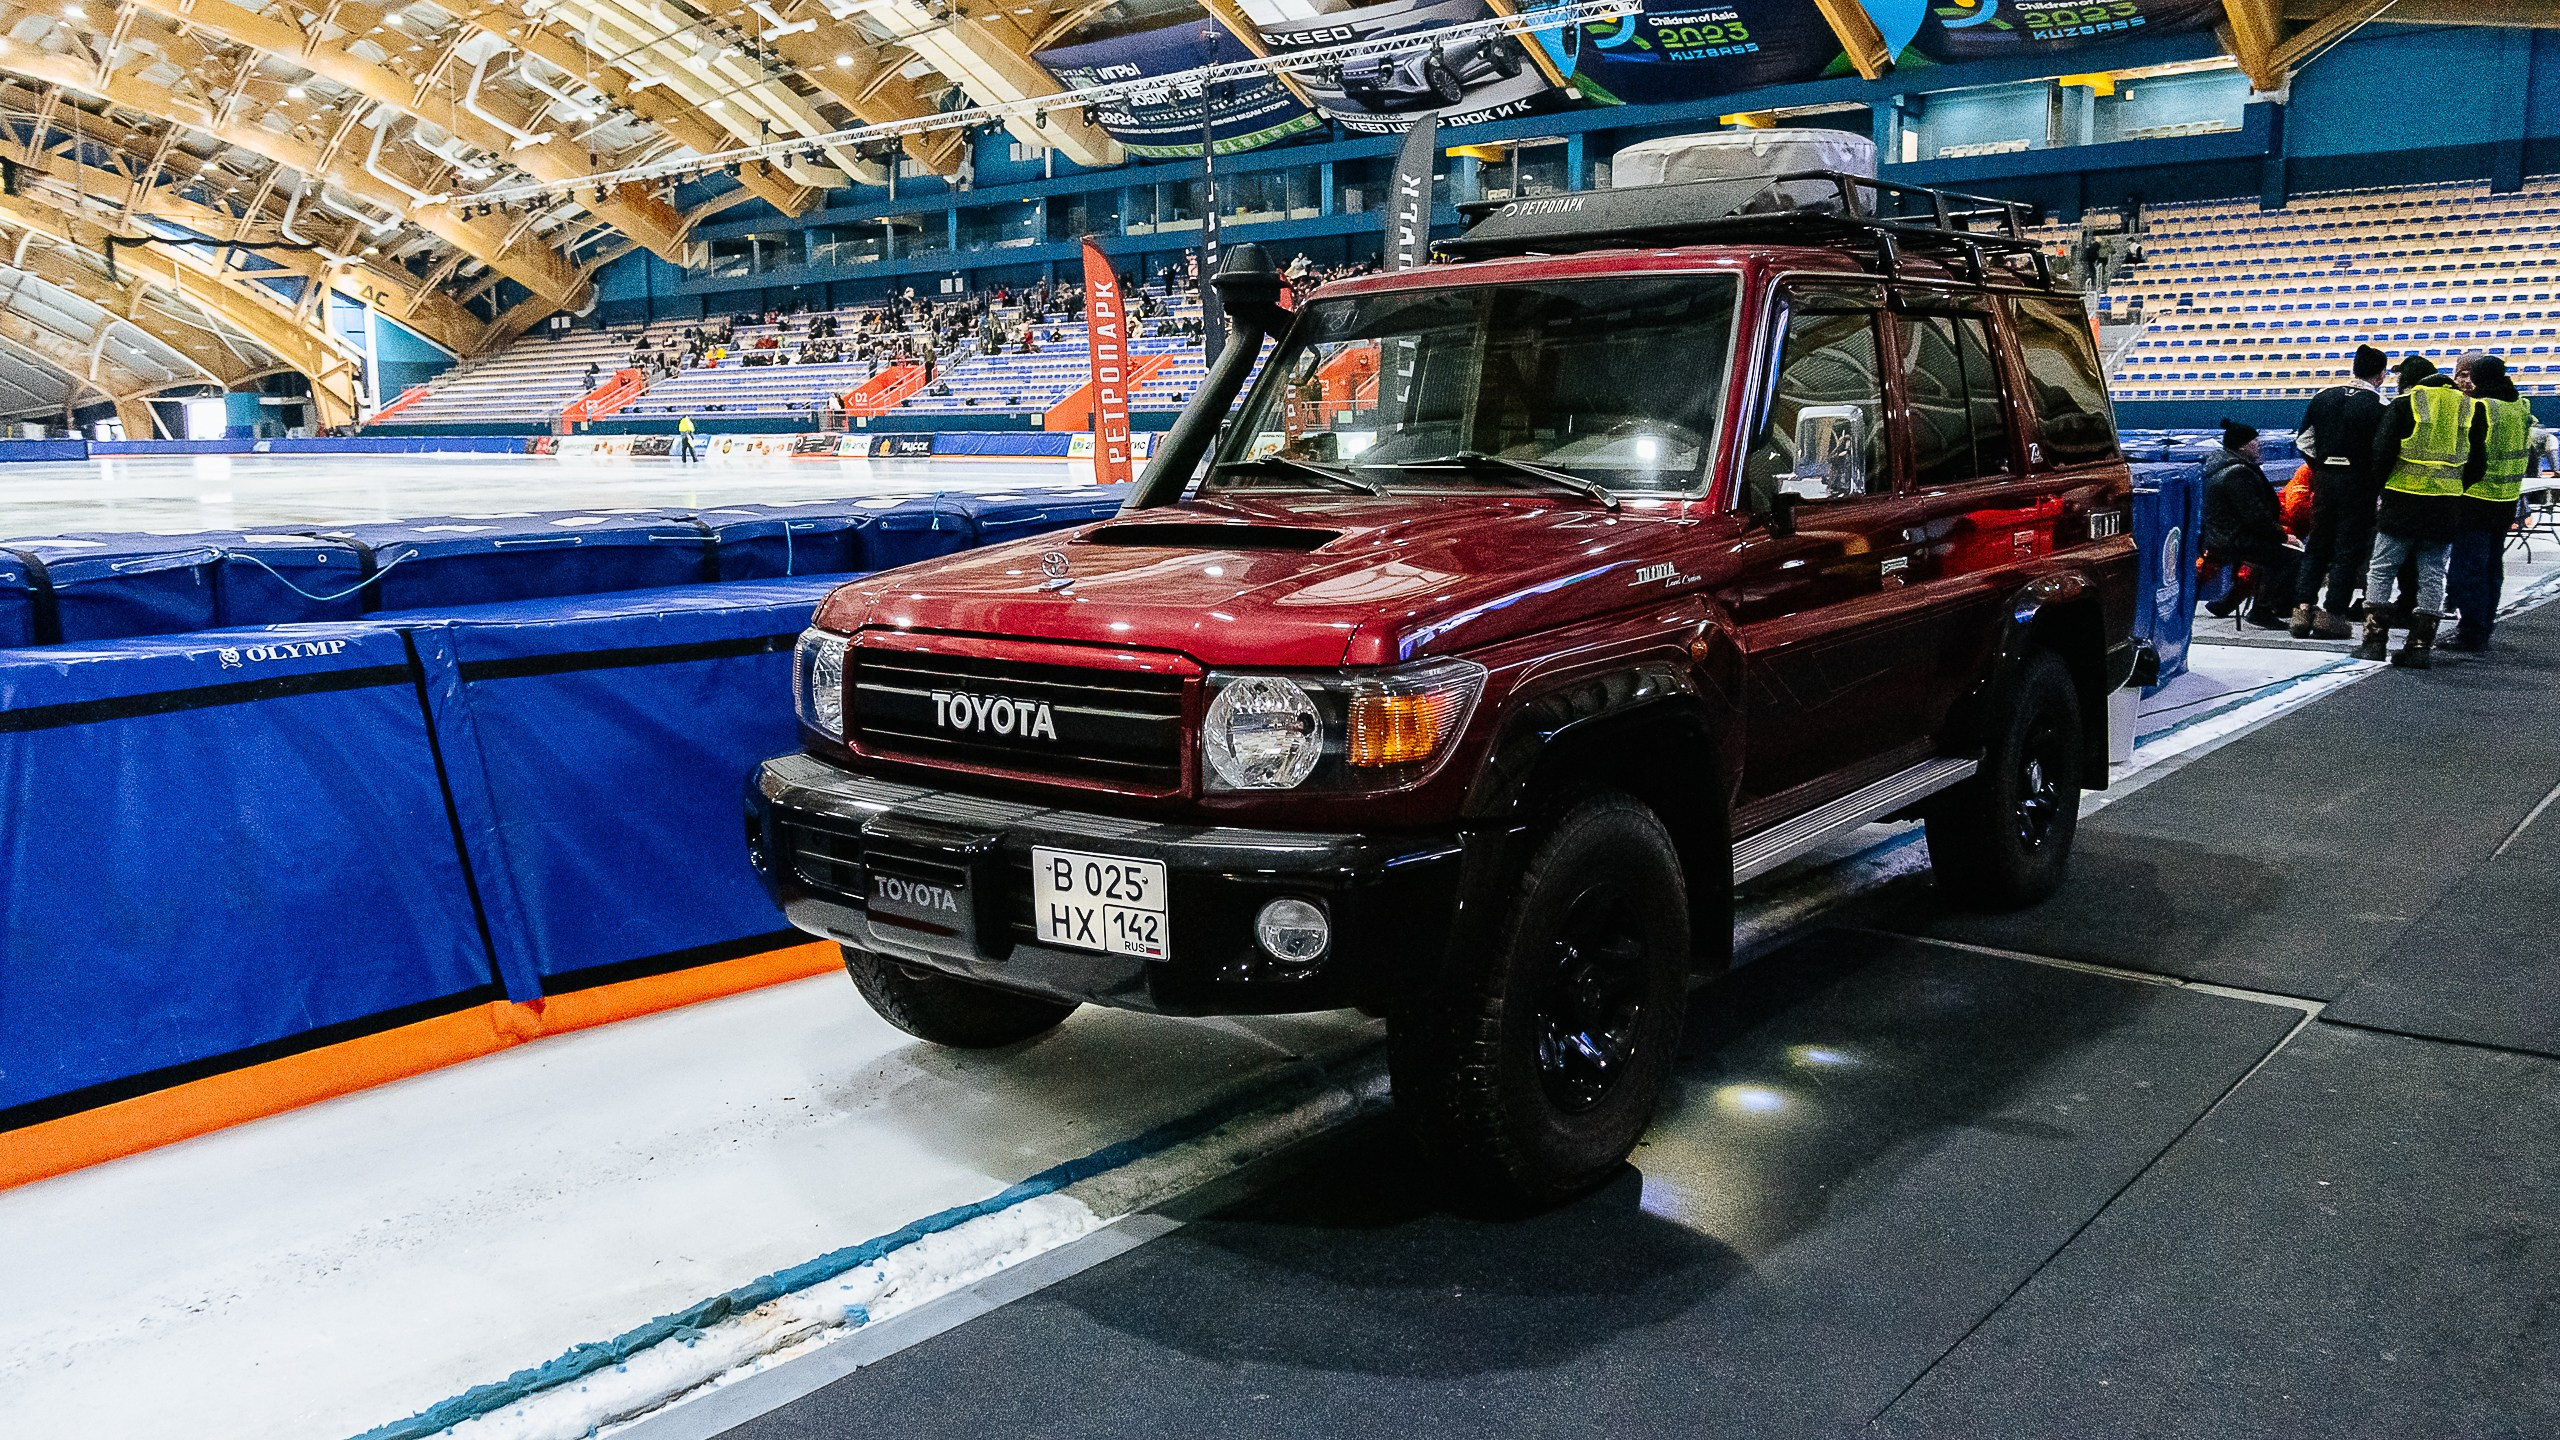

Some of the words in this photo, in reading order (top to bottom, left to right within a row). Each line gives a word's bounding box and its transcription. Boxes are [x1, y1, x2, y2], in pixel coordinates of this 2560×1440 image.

[1649, 16, 1699, 26] Children
[1699, 14, 1711, 22] of
[1711, 11, 1738, 20] Asia
[2024, 2, 2138, 28] 2023
[1259, 26, 1353, 46] EXEED
[1658, 22, 1749, 48] 2023
[2033, 16, 2146, 40] KUZBASS
[1669, 42, 1759, 61] KUZBASS
[1096, 62, 1141, 82] ИГРЫ
[1340, 120, 1389, 134] EXEED
[1447, 110, 1496, 129] ДЮК
[1499, 105, 1515, 118] И
[1515, 99, 1533, 112] К
[1519, 197, 1586, 216] РЕТРОПАРК
[1094, 281, 1128, 464] РЕТРОПАРК
[855, 392, 868, 403] D2
[246, 640, 346, 662] OLYMP
[931, 690, 1057, 740] TOYOTA
[874, 875, 958, 913] TOYOTA
[1085, 862, 1143, 902] 025
[1112, 911, 1159, 944] 142
[1124, 940, 1145, 953] RUS
